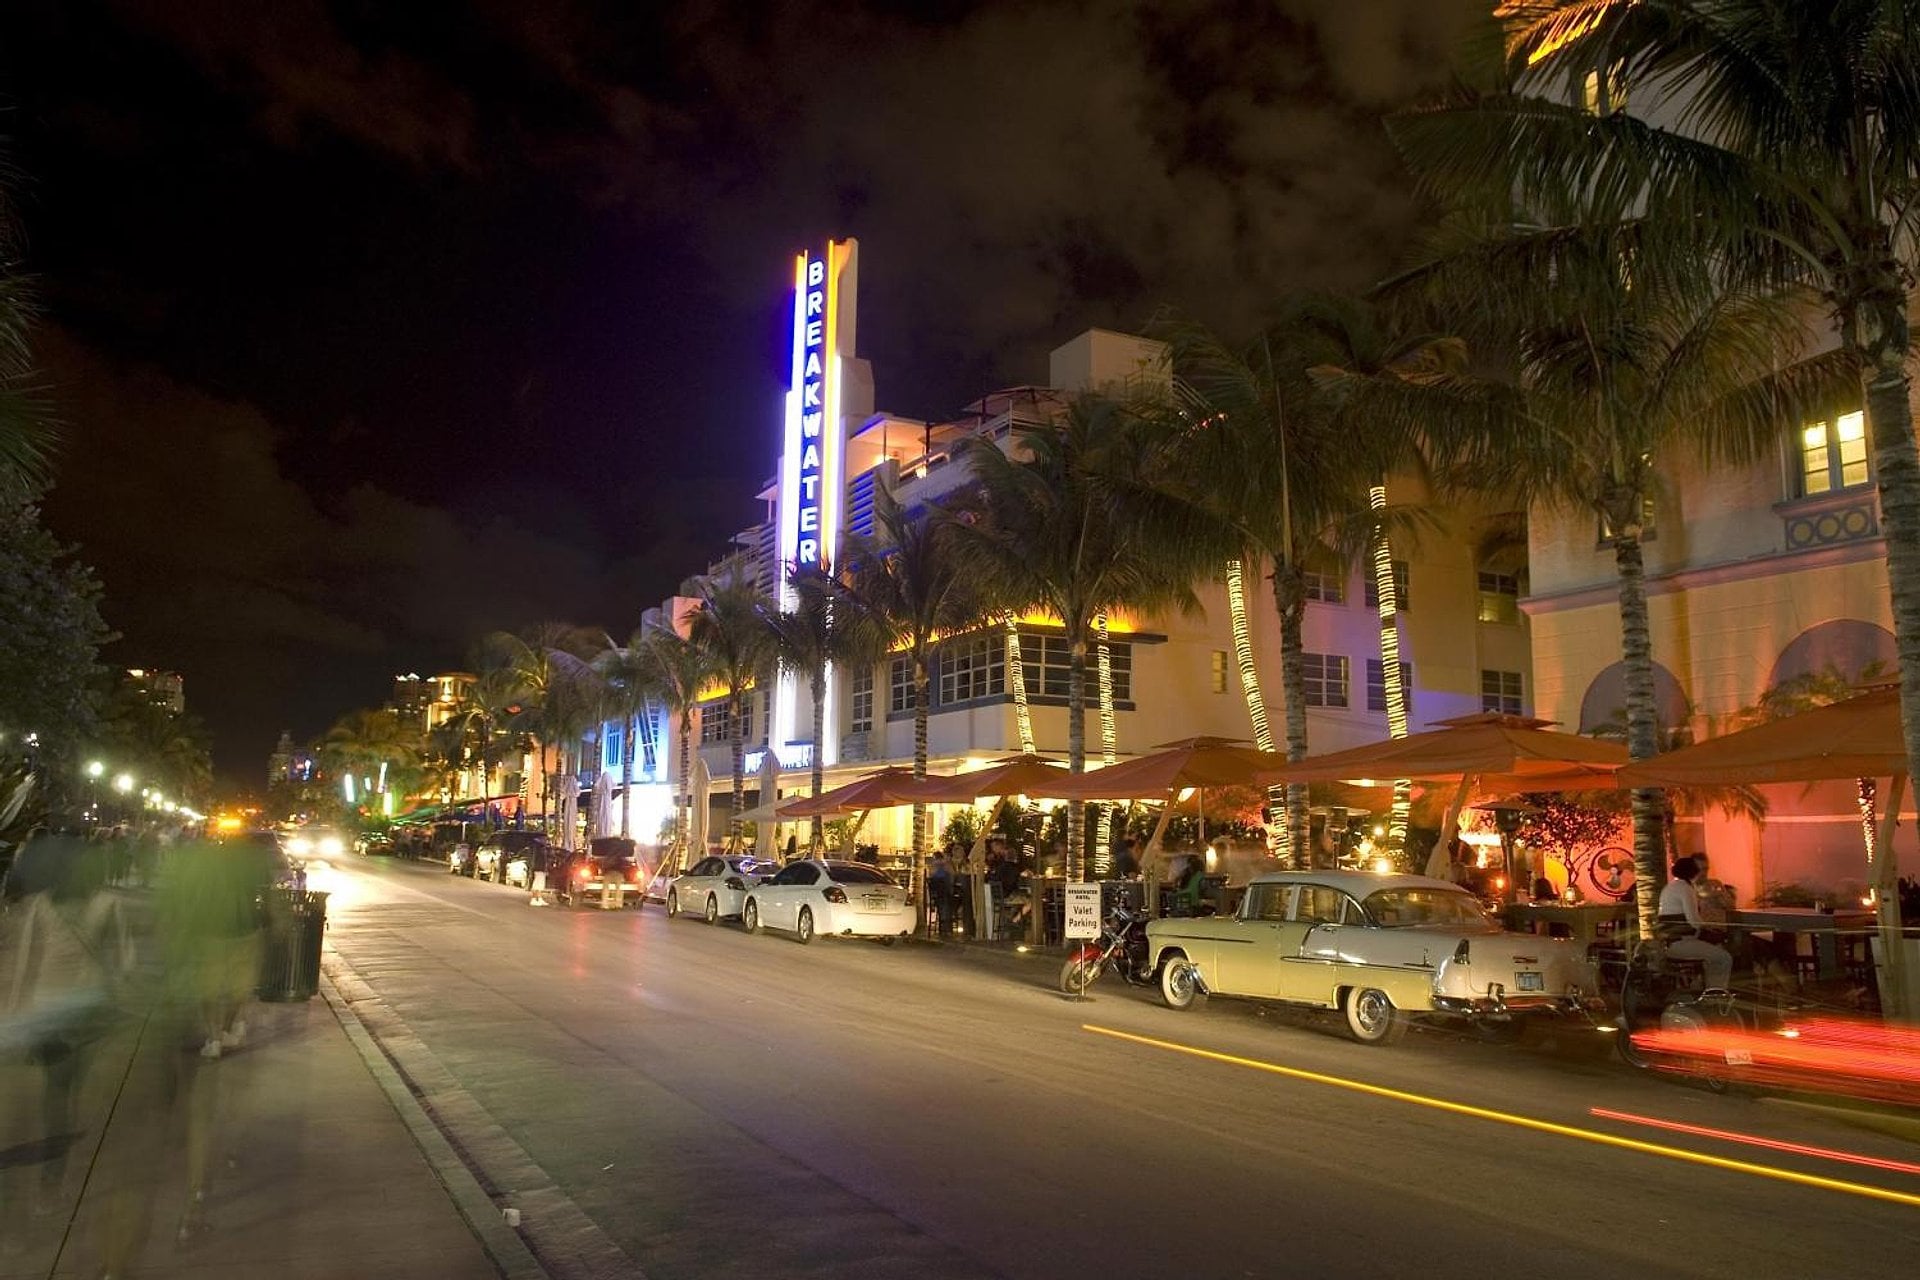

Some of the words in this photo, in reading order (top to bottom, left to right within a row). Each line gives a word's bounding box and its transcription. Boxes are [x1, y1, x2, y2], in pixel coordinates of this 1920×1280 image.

[800, 261, 824, 563] BREAKWATER
[1073, 906, 1092, 915] Valet
[1068, 918, 1097, 929] Parking
